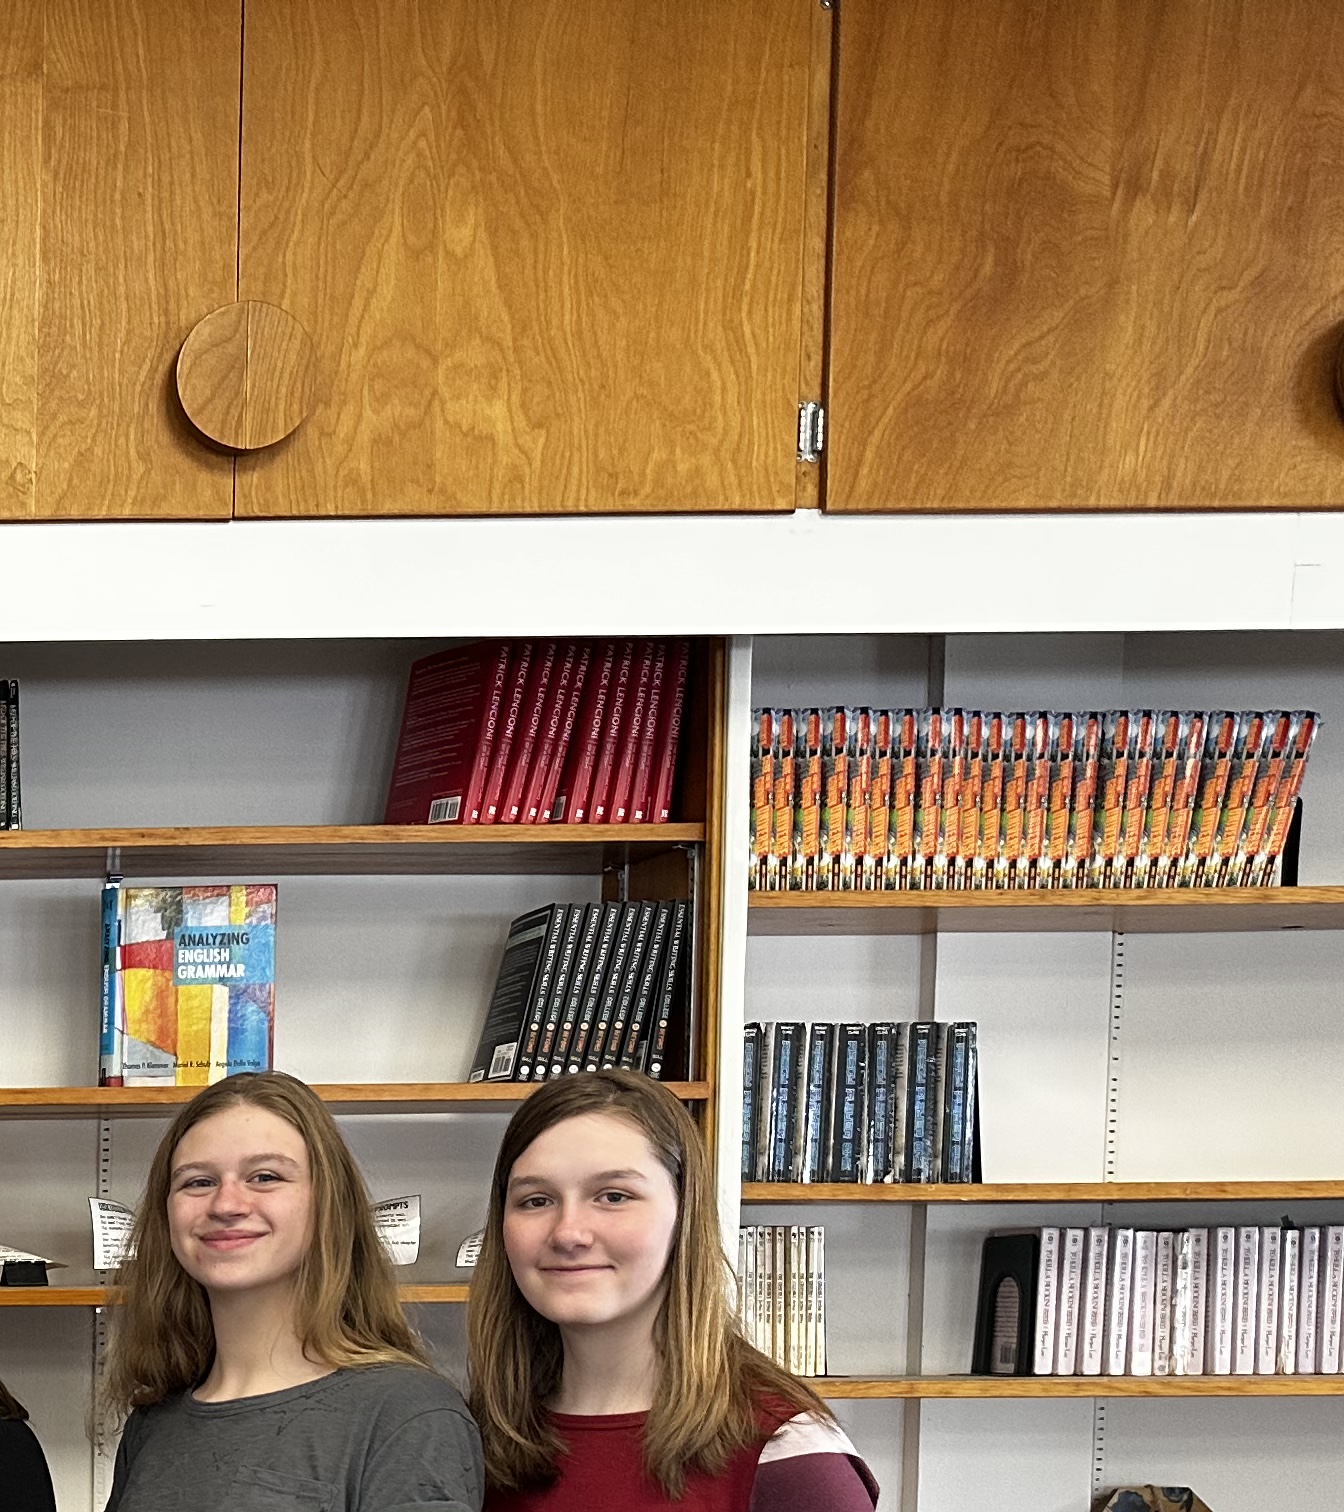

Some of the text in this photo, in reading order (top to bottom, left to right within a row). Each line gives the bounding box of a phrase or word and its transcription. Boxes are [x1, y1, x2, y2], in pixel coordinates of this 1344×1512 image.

[485, 646, 509, 740] PATRICK LENCIONI
[505, 644, 532, 737] PATRICK LENCIONI
[529, 644, 556, 737] PATRICK LENCIONI
[591, 645, 615, 739] PATRICK LENCIONI
[610, 642, 633, 737] PATRICK LENCIONI
[671, 642, 689, 738] PATRICK LENCIONI
[178, 948, 230, 964] ENGLISH
[178, 964, 245, 979] GRAMMAR
[179, 932, 250, 947] ANALYZING
